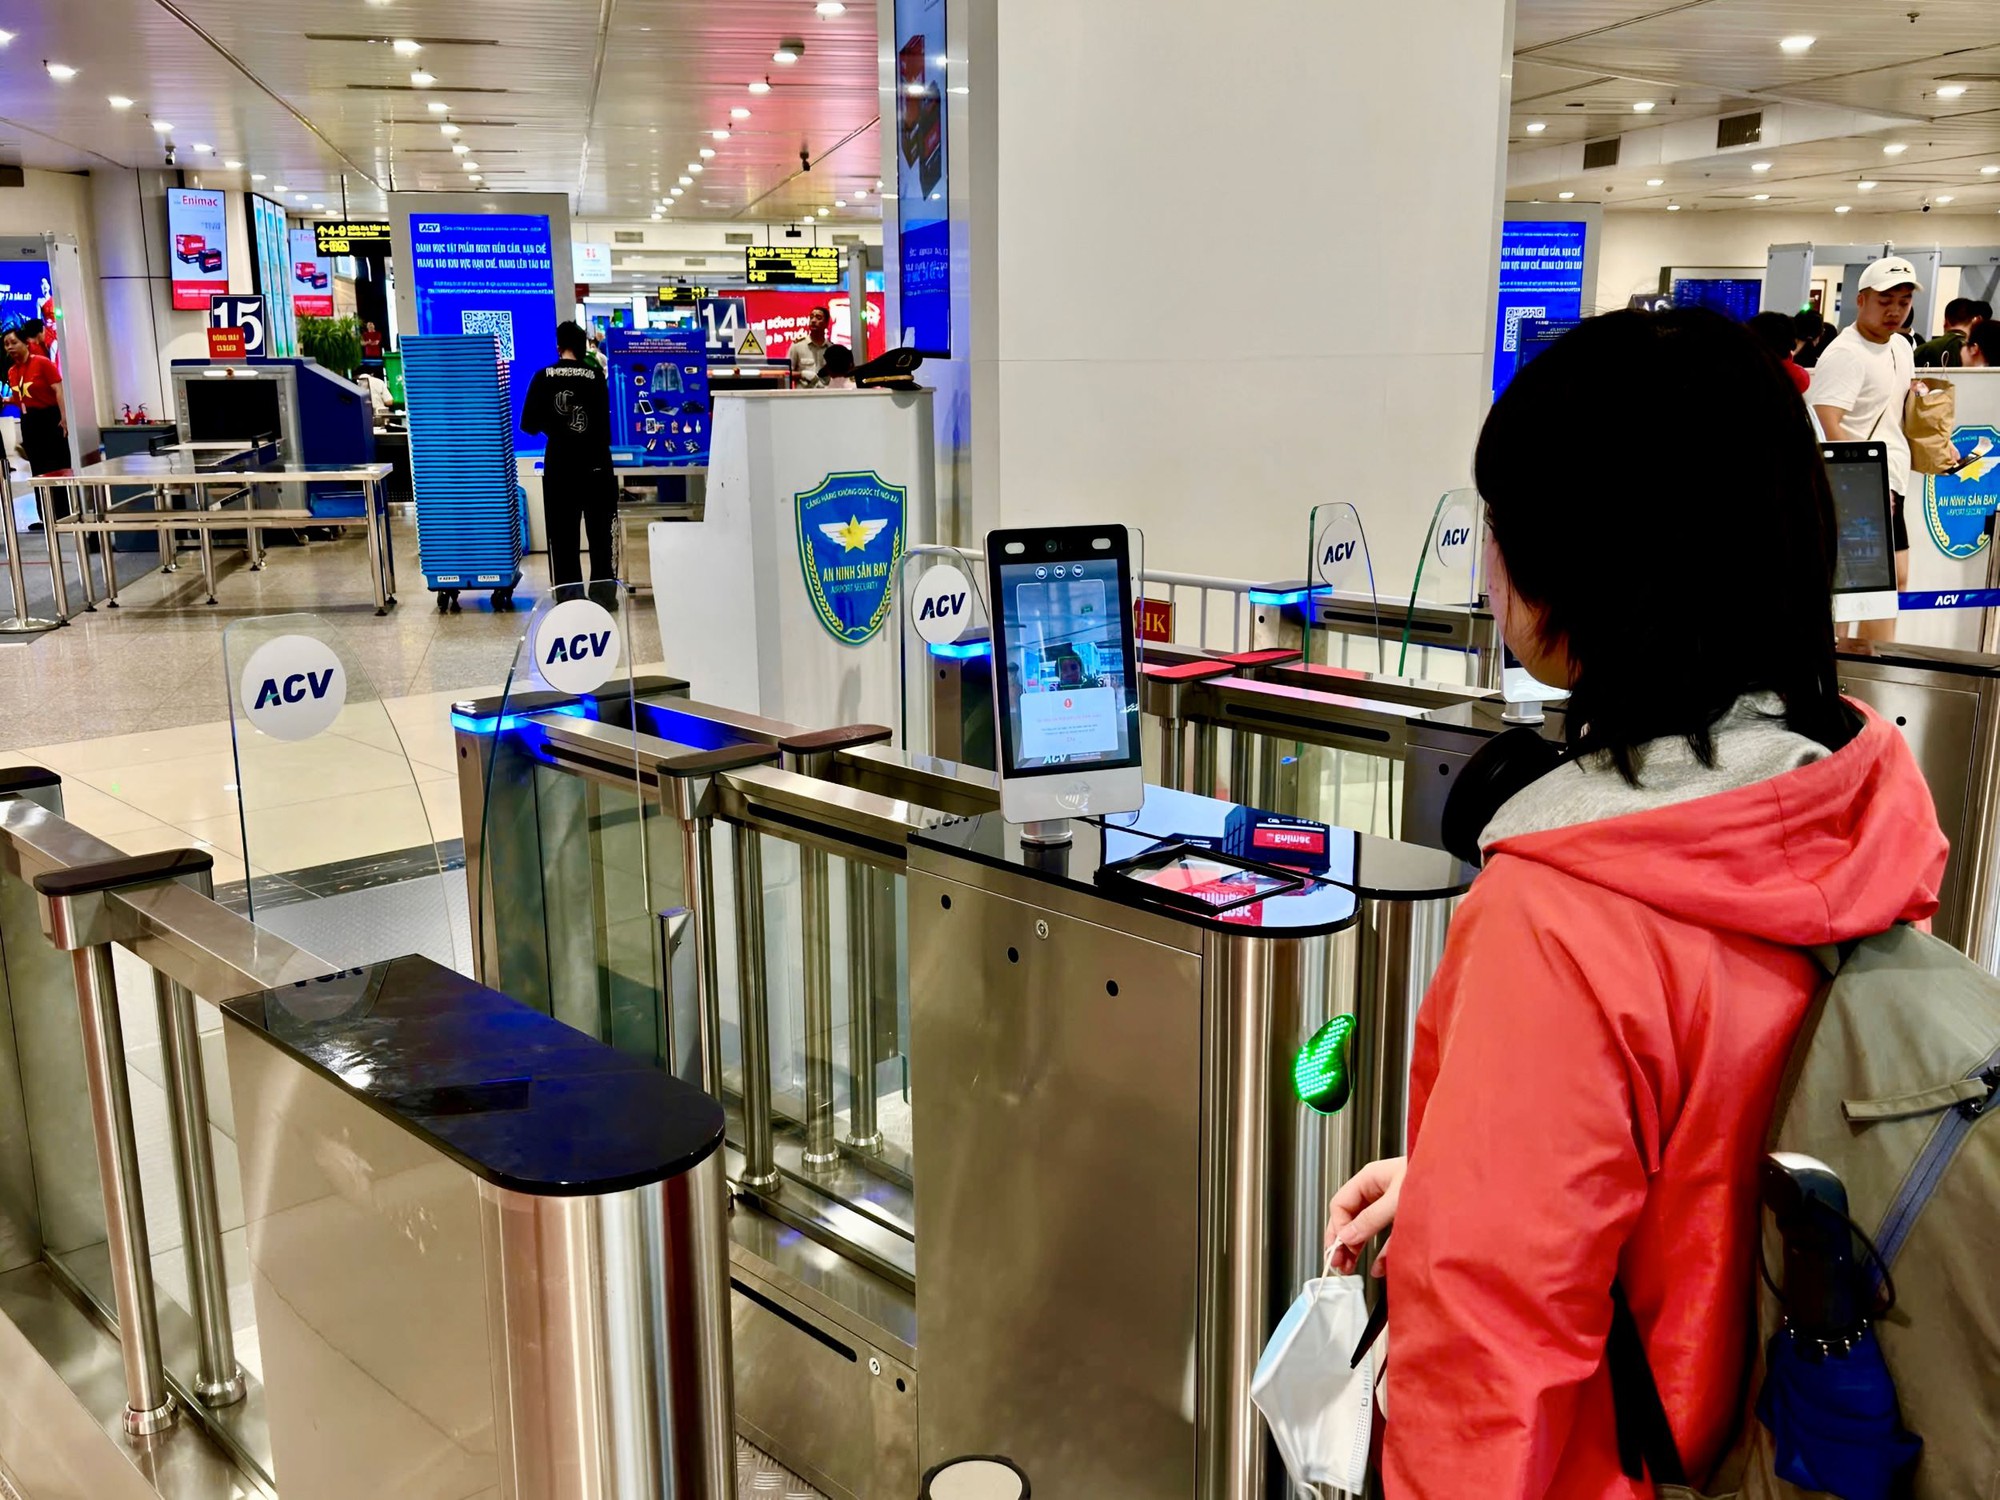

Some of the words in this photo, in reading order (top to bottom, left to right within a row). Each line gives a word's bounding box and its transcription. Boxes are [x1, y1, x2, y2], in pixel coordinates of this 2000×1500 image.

[182, 195, 218, 207] Enimac
[213, 301, 263, 350] 15
[702, 303, 738, 349] 14
[1938, 495, 1949, 507] AN
[1950, 495, 1967, 507] NINH
[1983, 494, 1998, 506] BAY
[1441, 527, 1470, 547] ACV
[1323, 541, 1356, 565] ACV
[823, 567, 834, 582] AN
[836, 565, 855, 580] NINH
[873, 562, 888, 577] BAY
[919, 592, 966, 621] ACV
[1935, 594, 1959, 606] ACV
[545, 631, 611, 665] ACV
[254, 669, 334, 710] ACV
[1042, 754, 1067, 765] ACV
